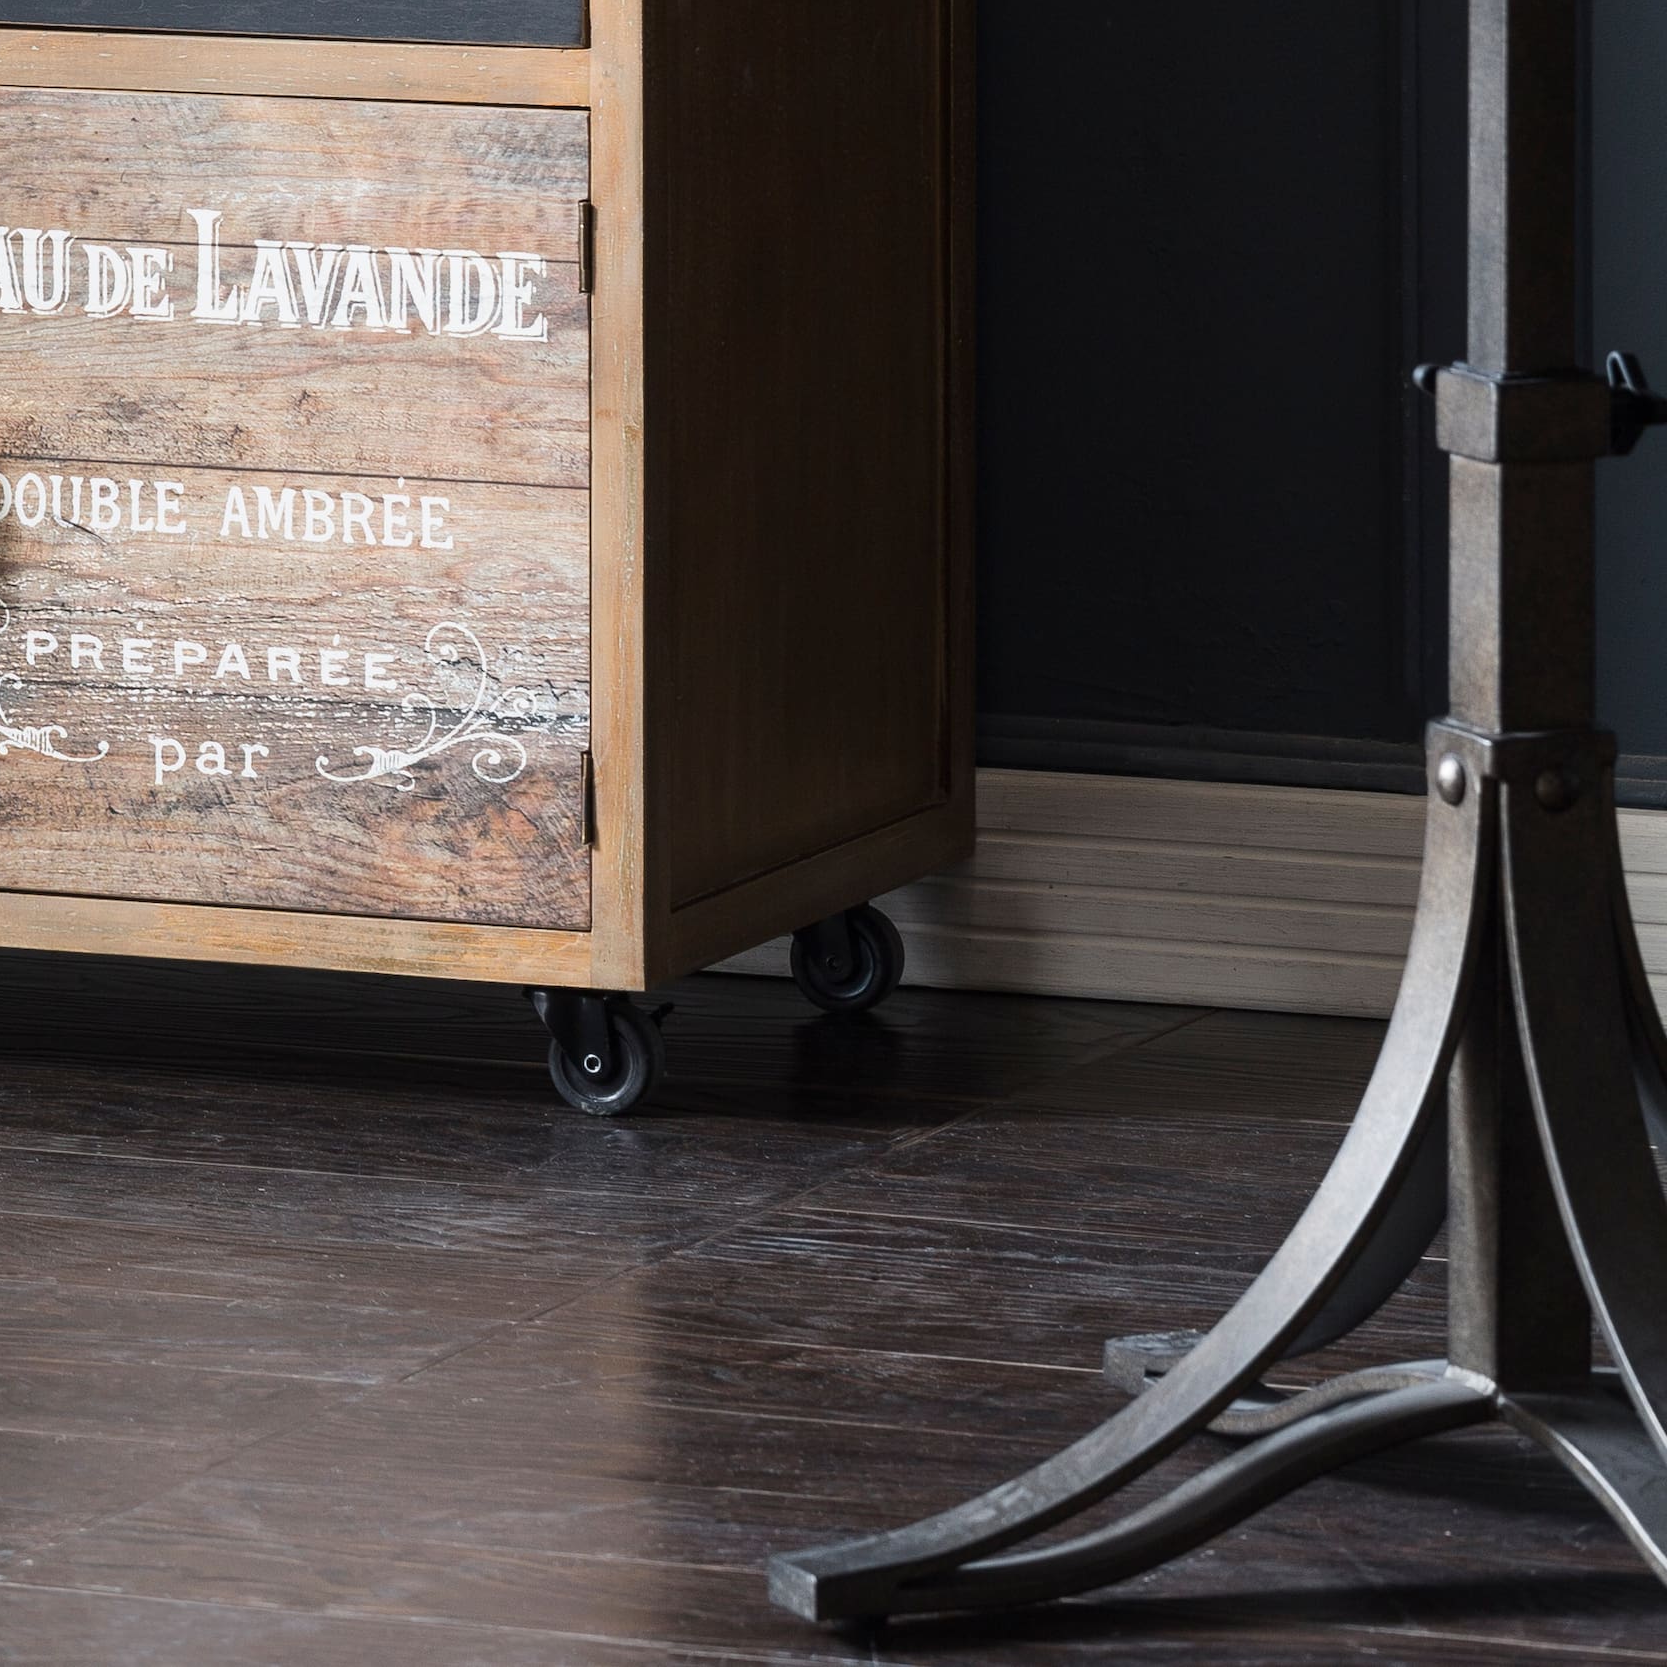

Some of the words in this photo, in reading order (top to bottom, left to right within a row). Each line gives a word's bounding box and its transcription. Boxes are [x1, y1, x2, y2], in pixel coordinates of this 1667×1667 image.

[81, 243, 175, 322] DE
[185, 207, 550, 343] LAVANDE
[220, 477, 456, 551] AMBRÉE
[24, 619, 399, 692] PRÉPARÉE
[147, 733, 270, 786] par
